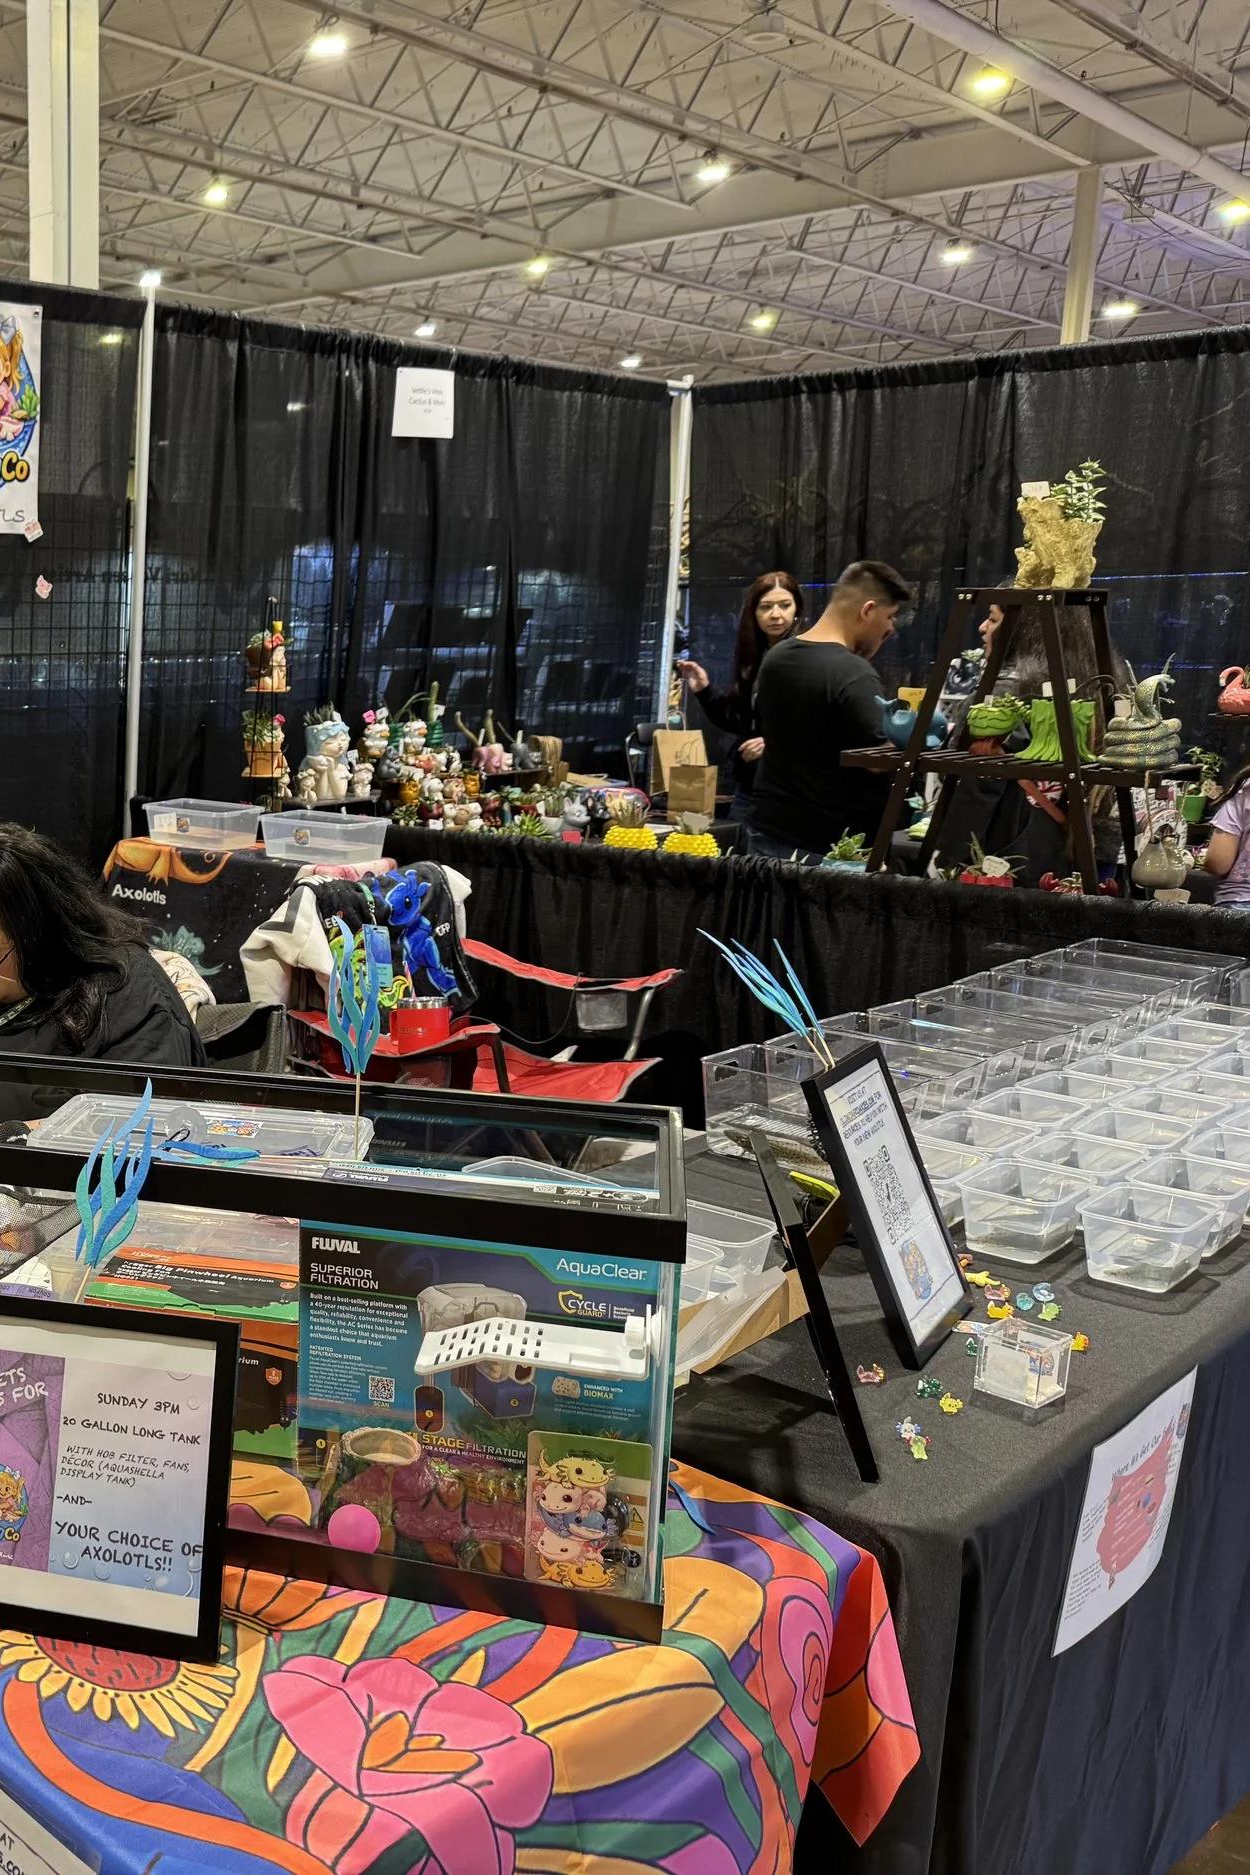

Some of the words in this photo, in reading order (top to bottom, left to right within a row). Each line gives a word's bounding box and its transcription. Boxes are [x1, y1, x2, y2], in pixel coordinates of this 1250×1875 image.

[111, 883, 167, 905] Axolotls
[311, 1236, 361, 1255] FLUVAL
[155, 1264, 174, 1273] Big
[177, 1267, 231, 1279] Pinwheel
[310, 1262, 373, 1279] SUPERIOR
[556, 1257, 648, 1280] AquaClear
[310, 1273, 379, 1290] FILTRATION
[310, 1292, 323, 1300] Built
[336, 1295, 369, 1306] best-selling
[369, 1300, 394, 1309] platform
[568, 1299, 607, 1313] CYCLE
[315, 1301, 336, 1310] 40-year
[337, 1304, 366, 1314] reputation
[376, 1309, 409, 1319] exceptional
[577, 1309, 603, 1318] GUARD
[357, 1322, 374, 1330] Series
[385, 1326, 408, 1334] become
[358, 1315, 393, 1325] convenience
[310, 1333, 340, 1341] enthusiasts
[341, 1335, 356, 1343] know
[368, 1339, 383, 1347] trust.
[314, 1325, 339, 1334] standout
[339, 1327, 358, 1336] choice
[371, 1331, 397, 1341] aquarium
[12, 1381, 49, 1403] FOR
[584, 1383, 610, 1392] ENHANCED
[584, 1389, 614, 1400] BIOMAX
[97, 1392, 149, 1409] SUNDAY
[153, 1401, 180, 1415] 3PM
[63, 1416, 77, 1426] 20
[80, 1419, 129, 1434] GALLON
[132, 1425, 166, 1440] LONG
[169, 1431, 202, 1446] TANK
[422, 1432, 465, 1449] STAGE
[466, 1442, 527, 1459] FILTRATION
[66, 1444, 94, 1456] WITH
[96, 1448, 116, 1460] HOB
[118, 1452, 159, 1469] FILTER,
[162, 1459, 191, 1474] FANS,
[439, 1447, 457, 1455] CLEAR
[461, 1451, 485, 1459] HEALTHY
[486, 1454, 525, 1465] ENVIRONMENT
[61, 1454, 95, 1469] DÉCOR
[97, 1460, 165, 1480] (AQUASHELLA
[60, 1467, 104, 1481] DISPLAY
[106, 1474, 136, 1488] TANK)
[56, 1494, 93, 1506] -AND-
[54, 1520, 101, 1542] YOUR
[107, 1529, 174, 1553] CHOICE
[180, 1542, 203, 1557] OF
[81, 1545, 172, 1572] AXOLOTLS!!
[0, 1831, 16, 1852] AT
